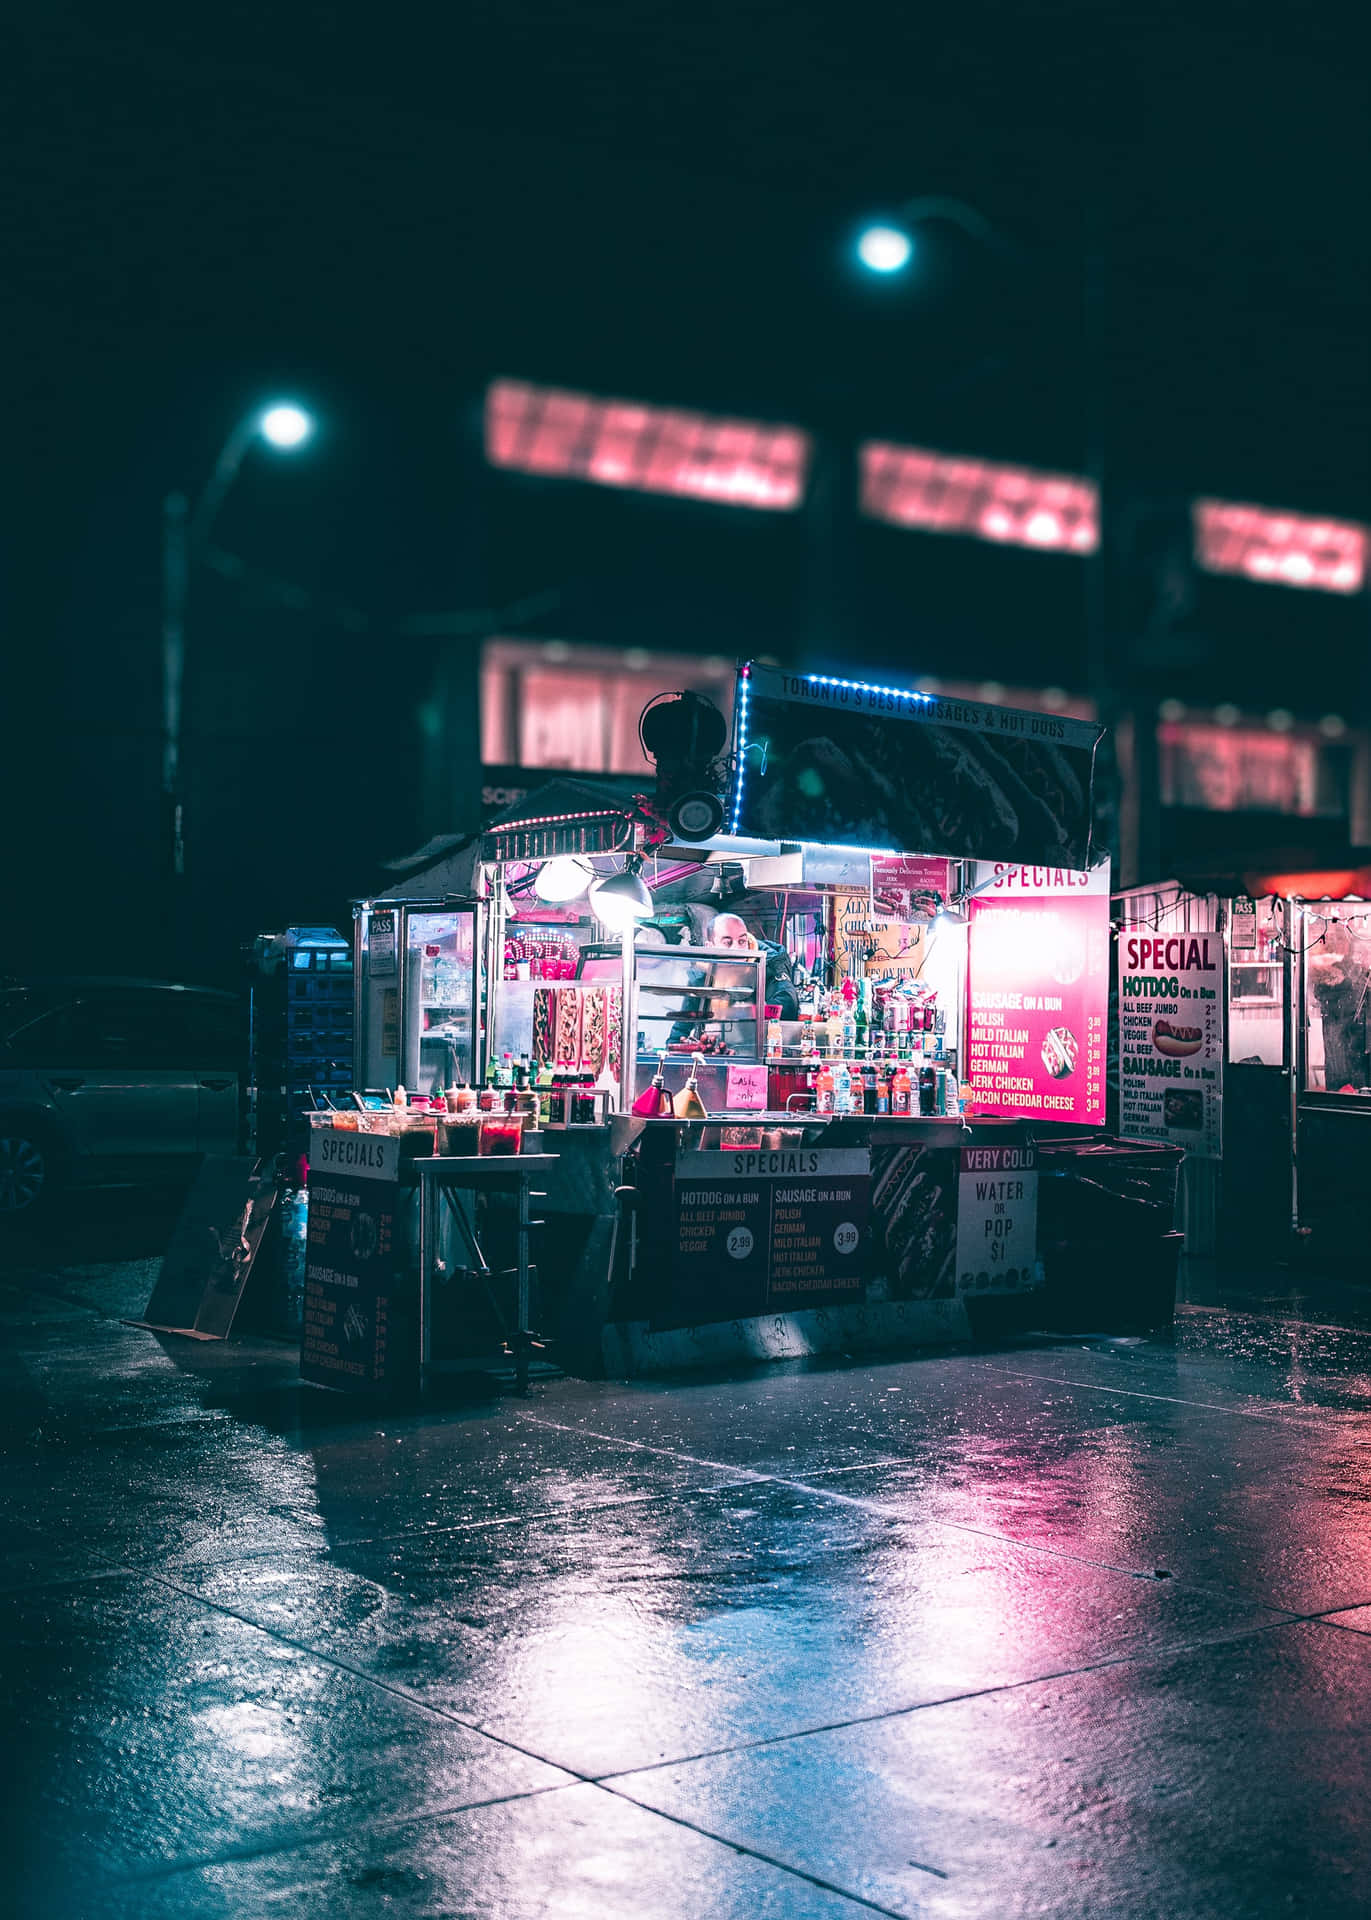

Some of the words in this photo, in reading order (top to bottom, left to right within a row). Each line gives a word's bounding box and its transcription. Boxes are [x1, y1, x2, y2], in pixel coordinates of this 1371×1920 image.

[784, 676, 863, 705] TORONTOS
[909, 698, 979, 725] SAUSAGES
[1000, 713, 1026, 729] HOT
[1031, 719, 1065, 738] DOGS
[994, 863, 1089, 889] SPECIALS
[1235, 903, 1253, 913] PASS
[372, 920, 391, 933] PASS
[845, 920, 888, 932] CHICEN
[1128, 938, 1216, 971] SPECIAL
[1123, 976, 1179, 998] HOTDOG
[1180, 986, 1191, 999] On
[1193, 990, 1198, 999] a
[1200, 986, 1216, 999] Bun
[971, 991, 1022, 1010] SAUSAGE
[1023, 996, 1036, 1010] ON
[1037, 997, 1043, 1010] A
[1045, 997, 1062, 1011] BUN
[1123, 1003, 1135, 1013] ALL
[1136, 1003, 1152, 1013] BEEF
[1154, 1004, 1178, 1014] JUMBO
[971, 1012, 1004, 1026] POLISH
[1123, 1016, 1152, 1027] CHICKEN
[971, 1028, 994, 1041] MILD
[995, 1030, 1029, 1043] ITALIAN
[1123, 1029, 1147, 1040] VEGGIE
[971, 1044, 990, 1057] HOT
[991, 1045, 1024, 1059] ITALIAN
[1123, 1044, 1135, 1053] ALL
[1136, 1045, 1153, 1055] BEEF
[970, 1059, 1009, 1074] GERMAN
[1123, 1057, 1181, 1078] SAUSAGE
[1184, 1066, 1194, 1078] On
[970, 1075, 994, 1089] JERK
[995, 1076, 1033, 1091] CHICKEN
[1123, 1078, 1145, 1088] POLISH
[1002, 1093, 1042, 1108] CHEDDAR
[1044, 1096, 1075, 1111] CHEESE
[322, 1139, 384, 1168] SPECIALS
[966, 1149, 1000, 1169] VERY
[1003, 1149, 1034, 1168] COLD
[734, 1153, 818, 1174] SPECIALS
[681, 1191, 722, 1206] HOTDOG
[723, 1192, 735, 1205] ON
[736, 1192, 741, 1204] A
[743, 1191, 760, 1204] BUN
[776, 1189, 817, 1203] SAUSAGE
[818, 1191, 828, 1201] ON
[829, 1191, 834, 1200] A
[836, 1190, 852, 1200] BUN
[976, 1182, 1023, 1200] WATER
[994, 1203, 1005, 1214] OR
[985, 1219, 1013, 1237] POP
[731, 1236, 751, 1251] 2.99
[838, 1231, 856, 1246] 3.99
[991, 1240, 1005, 1261] $1
